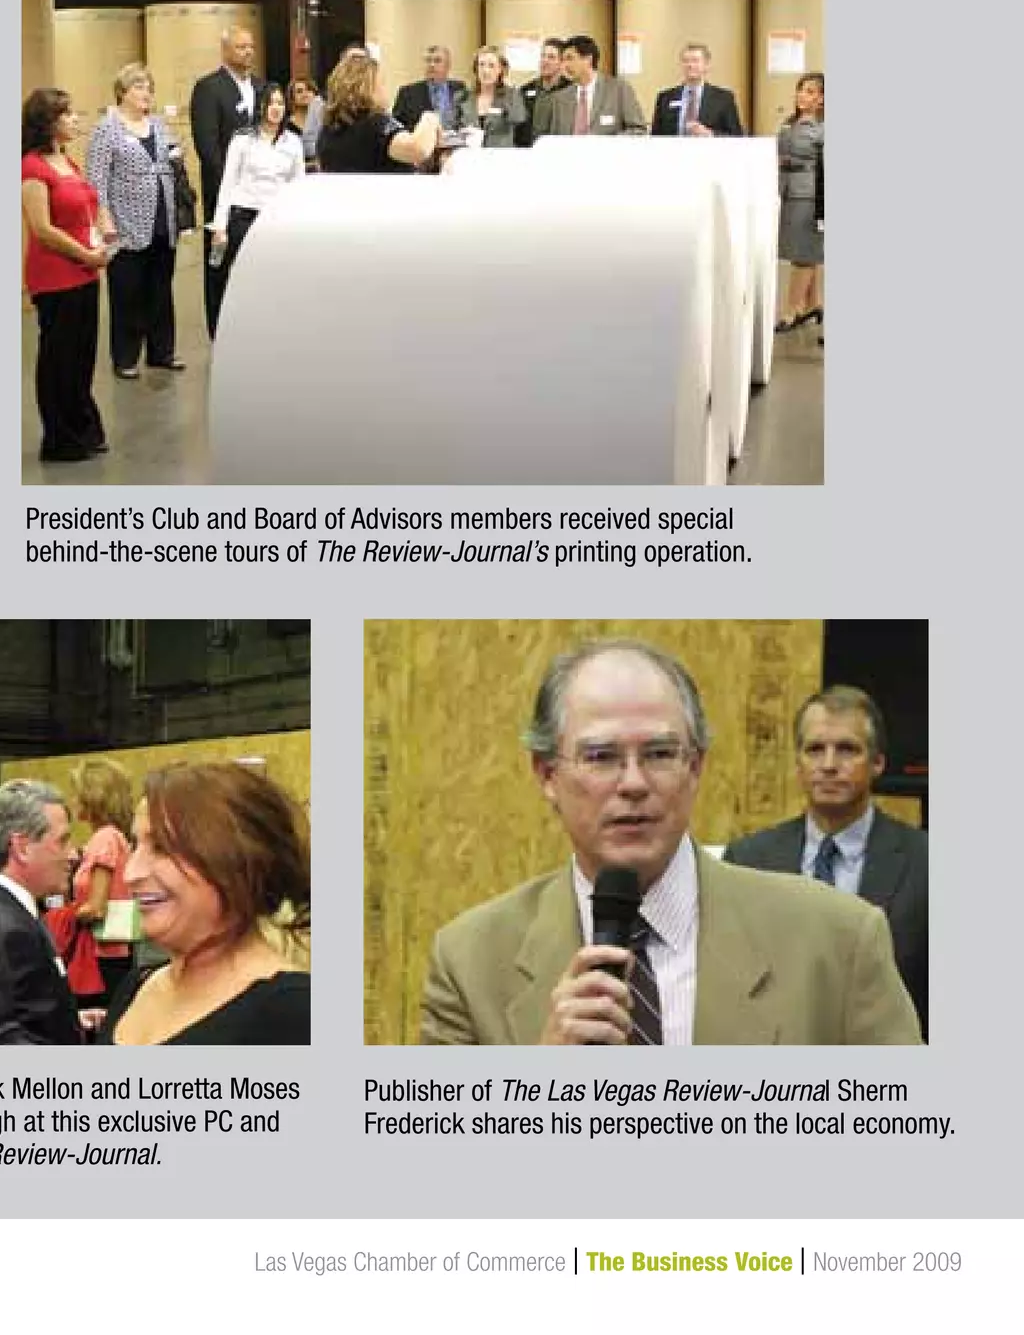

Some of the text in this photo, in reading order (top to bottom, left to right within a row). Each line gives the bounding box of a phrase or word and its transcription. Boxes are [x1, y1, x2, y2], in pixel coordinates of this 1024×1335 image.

[27, 540, 217, 562] behind-the-scene
[224, 541, 279, 562] tours
[287, 540, 307, 562] of
[318, 540, 356, 562] The
[556, 540, 636, 567] printing
[645, 540, 751, 567] operation.
[13, 1077, 82, 1099] Mellon
[91, 1078, 129, 1099] and
[139, 1078, 222, 1099] Lorretta
[231, 1077, 299, 1099] Moses
[365, 1079, 907, 1106] Publisher of The Las Vegas Review-Journal Sherm
[365, 1112, 954, 1139] Frederick shares his perspective on the local economy.
[256, 1252, 565, 1275] Las Vegas Chamber of Commerce
[586, 1252, 792, 1272] The Business Voice
[815, 1252, 961, 1271] November 2009
